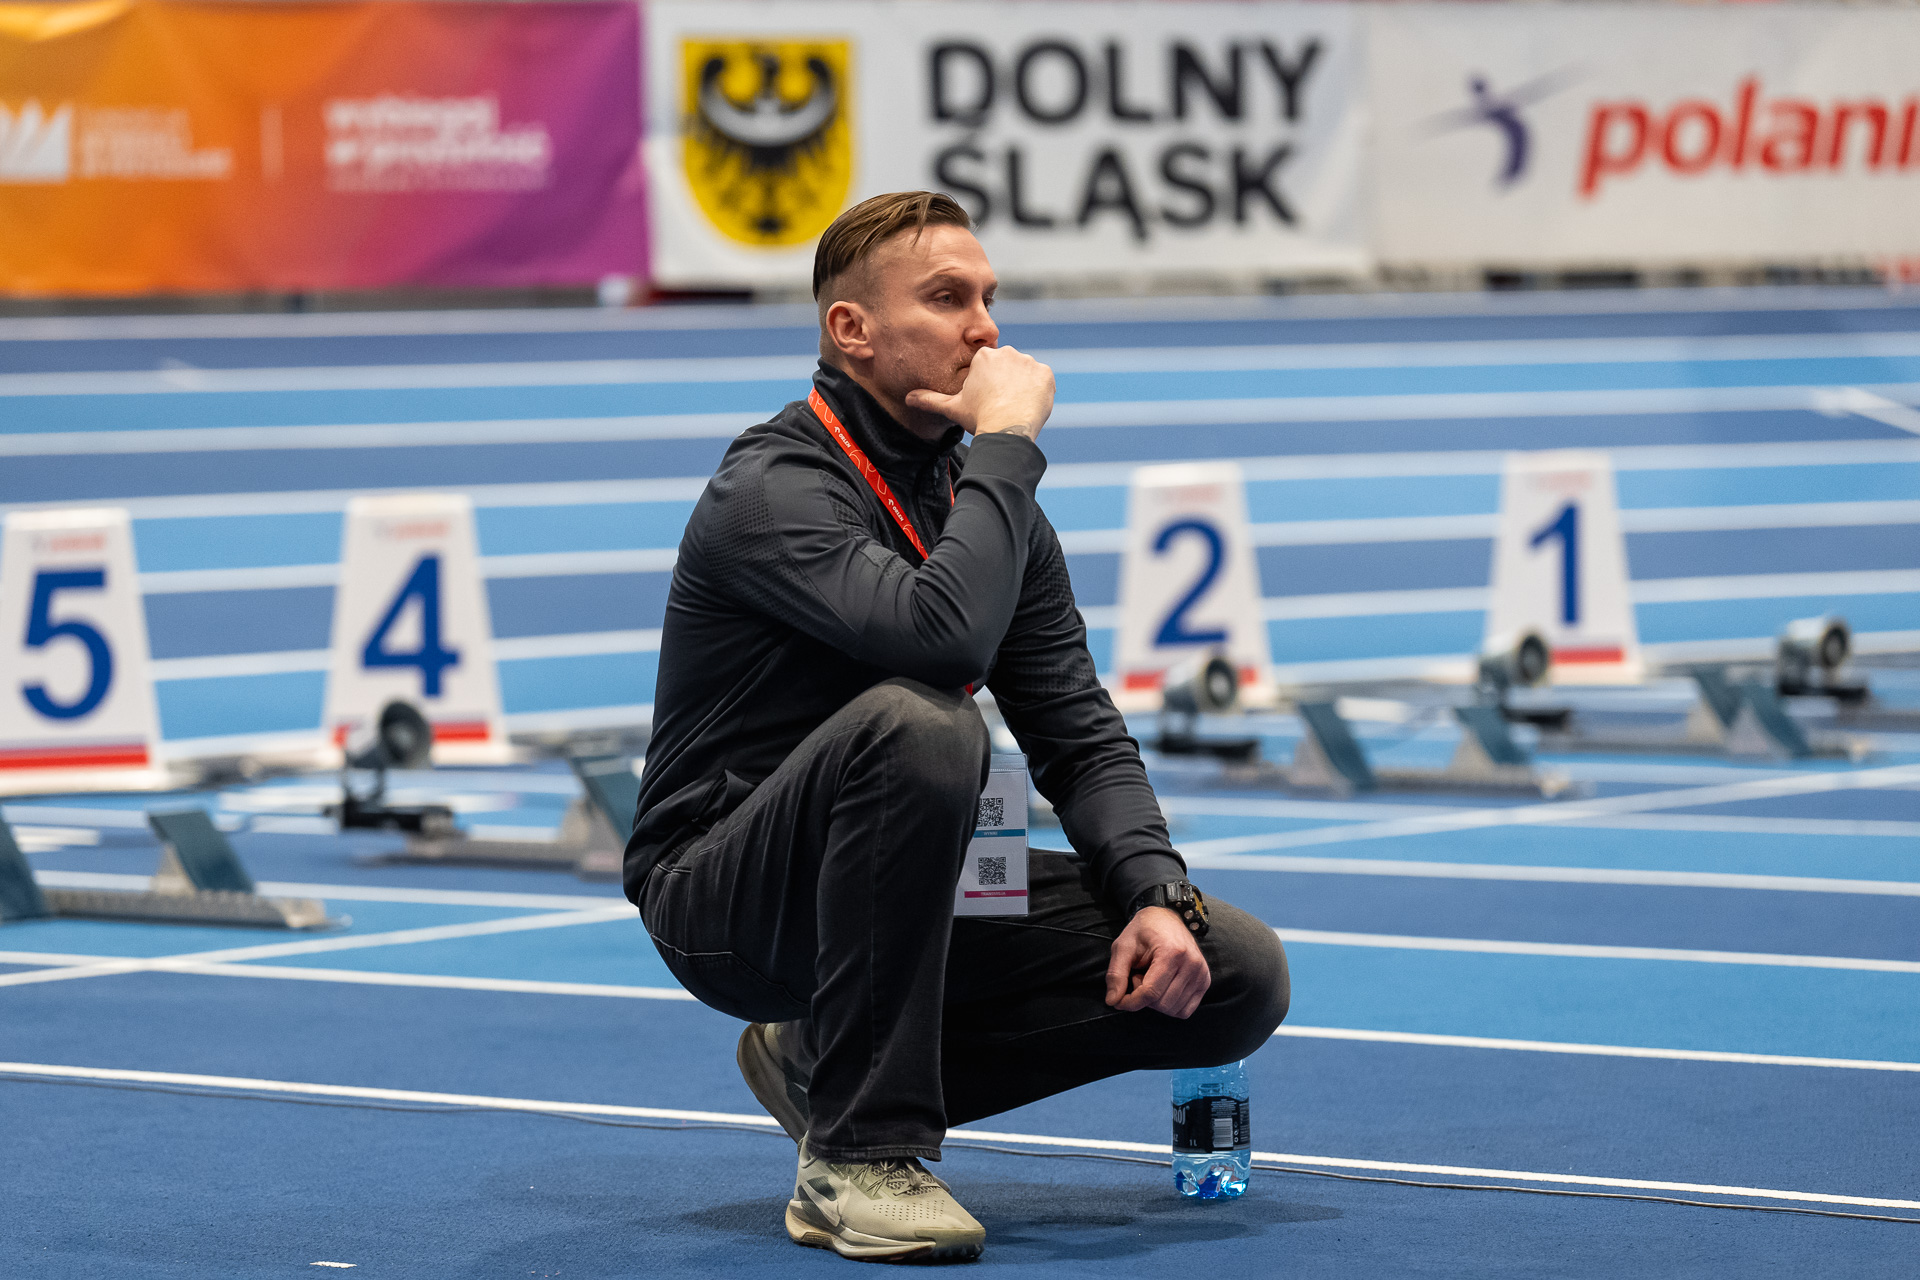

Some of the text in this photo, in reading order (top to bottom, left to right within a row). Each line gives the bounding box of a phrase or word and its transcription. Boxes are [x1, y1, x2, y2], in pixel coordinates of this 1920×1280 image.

[928, 39, 1321, 126] DOLNY
[933, 128, 1298, 244] ŚLĄSK
[838, 433, 851, 448] ORLEN
[892, 506, 905, 522] ORLEN
[1528, 500, 1580, 628] 1
[361, 553, 461, 699] 4
[1149, 516, 1230, 650] 2
[21, 567, 115, 723] 5
